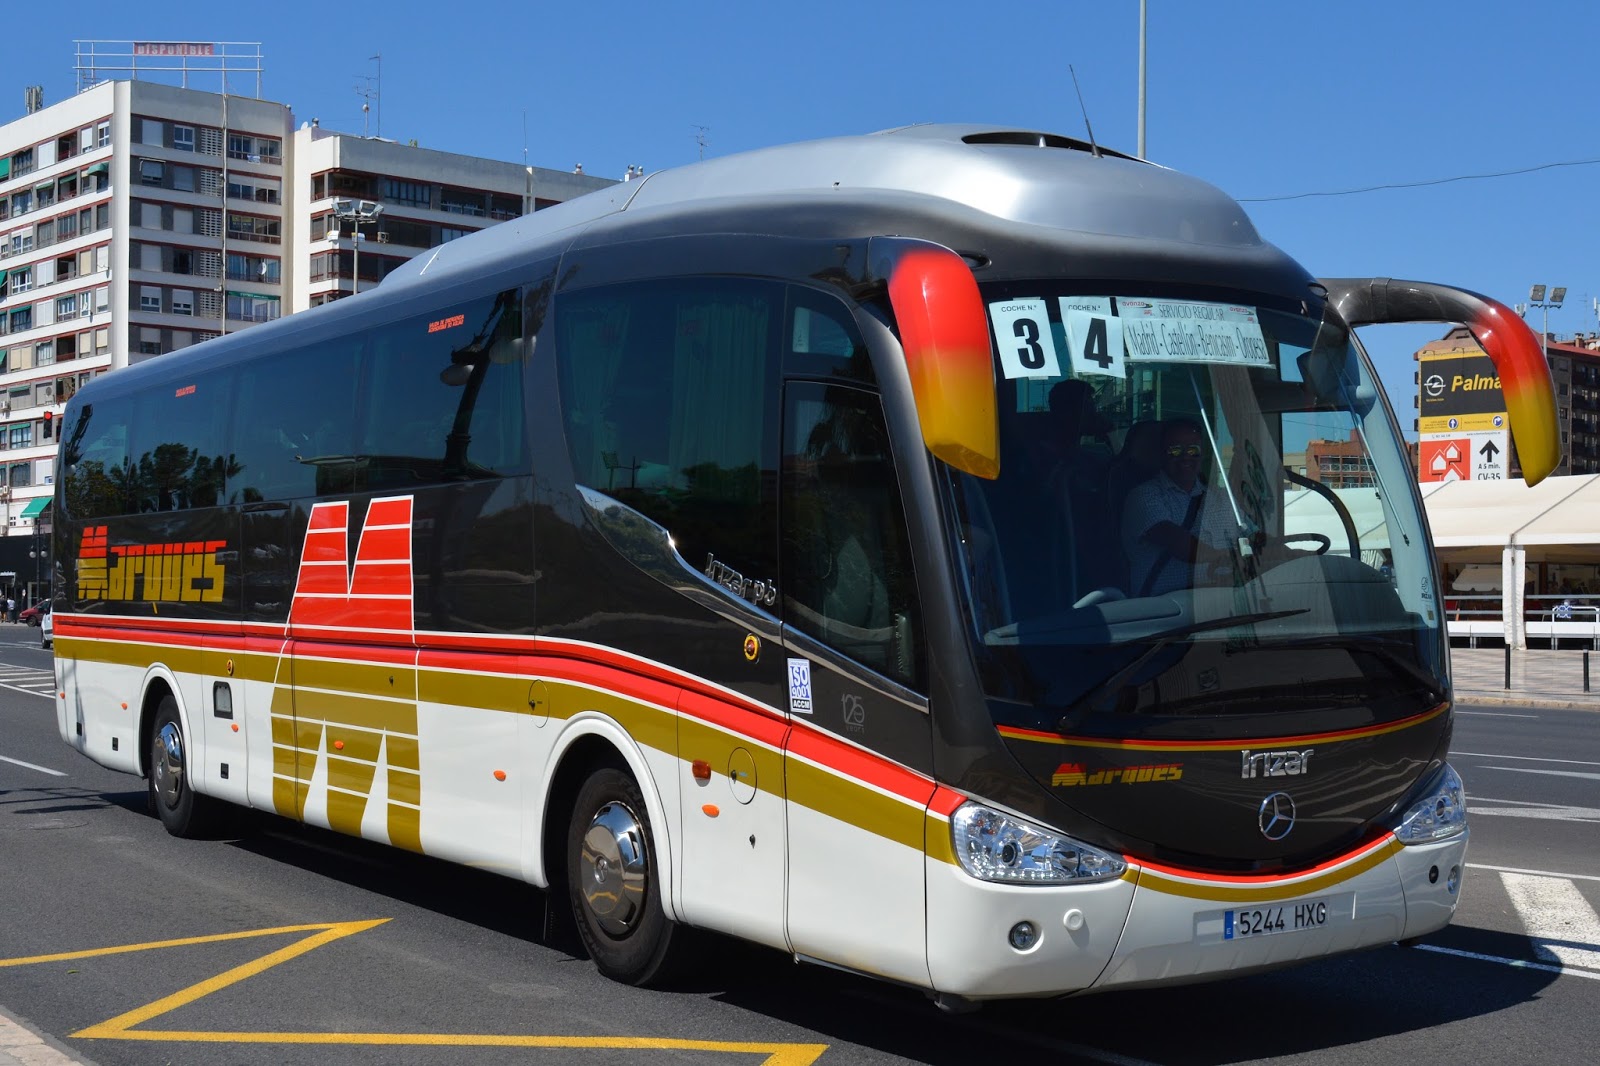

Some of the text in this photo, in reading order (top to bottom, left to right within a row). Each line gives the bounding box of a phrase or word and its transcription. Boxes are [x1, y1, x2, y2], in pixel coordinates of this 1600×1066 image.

[138, 43, 210, 55] DISPONIBLE
[1158, 304, 1225, 321] SERVICIO REGULAR
[1012, 318, 1046, 369] 3
[1083, 317, 1114, 369] 4
[1127, 320, 1160, 356] Madrid
[1451, 374, 1502, 392] Palma
[790, 665, 809, 687] ISO
[791, 685, 810, 698] 9001
[1240, 902, 1326, 935] 5244 HXG
